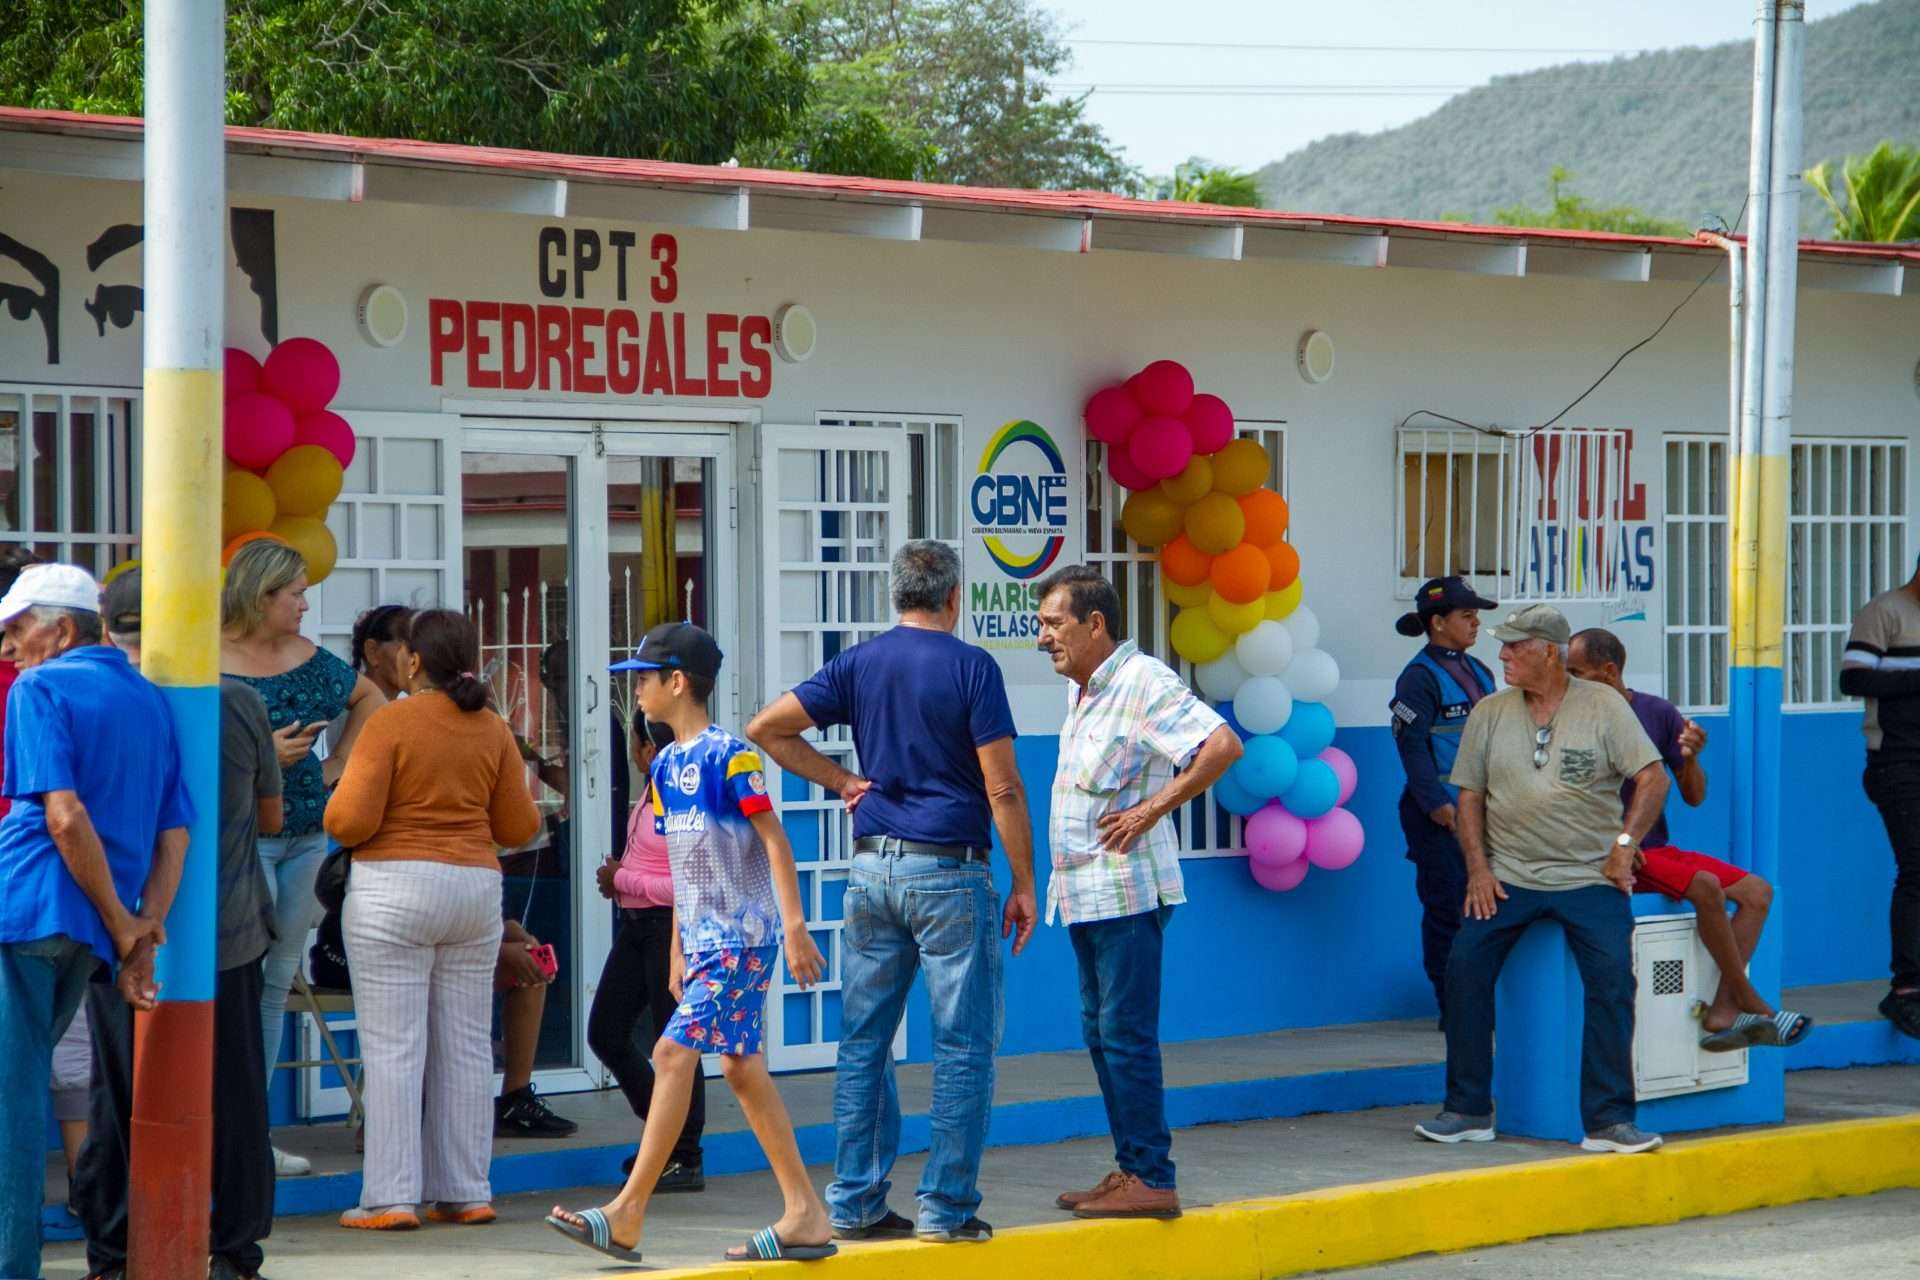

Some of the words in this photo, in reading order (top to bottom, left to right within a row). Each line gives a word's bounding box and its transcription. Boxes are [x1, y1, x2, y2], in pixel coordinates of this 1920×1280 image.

[539, 227, 636, 301] CPT
[650, 233, 679, 303] 3
[429, 298, 772, 398] PEDREGALES
[971, 475, 1067, 525] GBNE
[1529, 426, 1646, 521] YUL
[971, 581, 1040, 611] MARIS
[972, 611, 1039, 638] VELÁSQ
